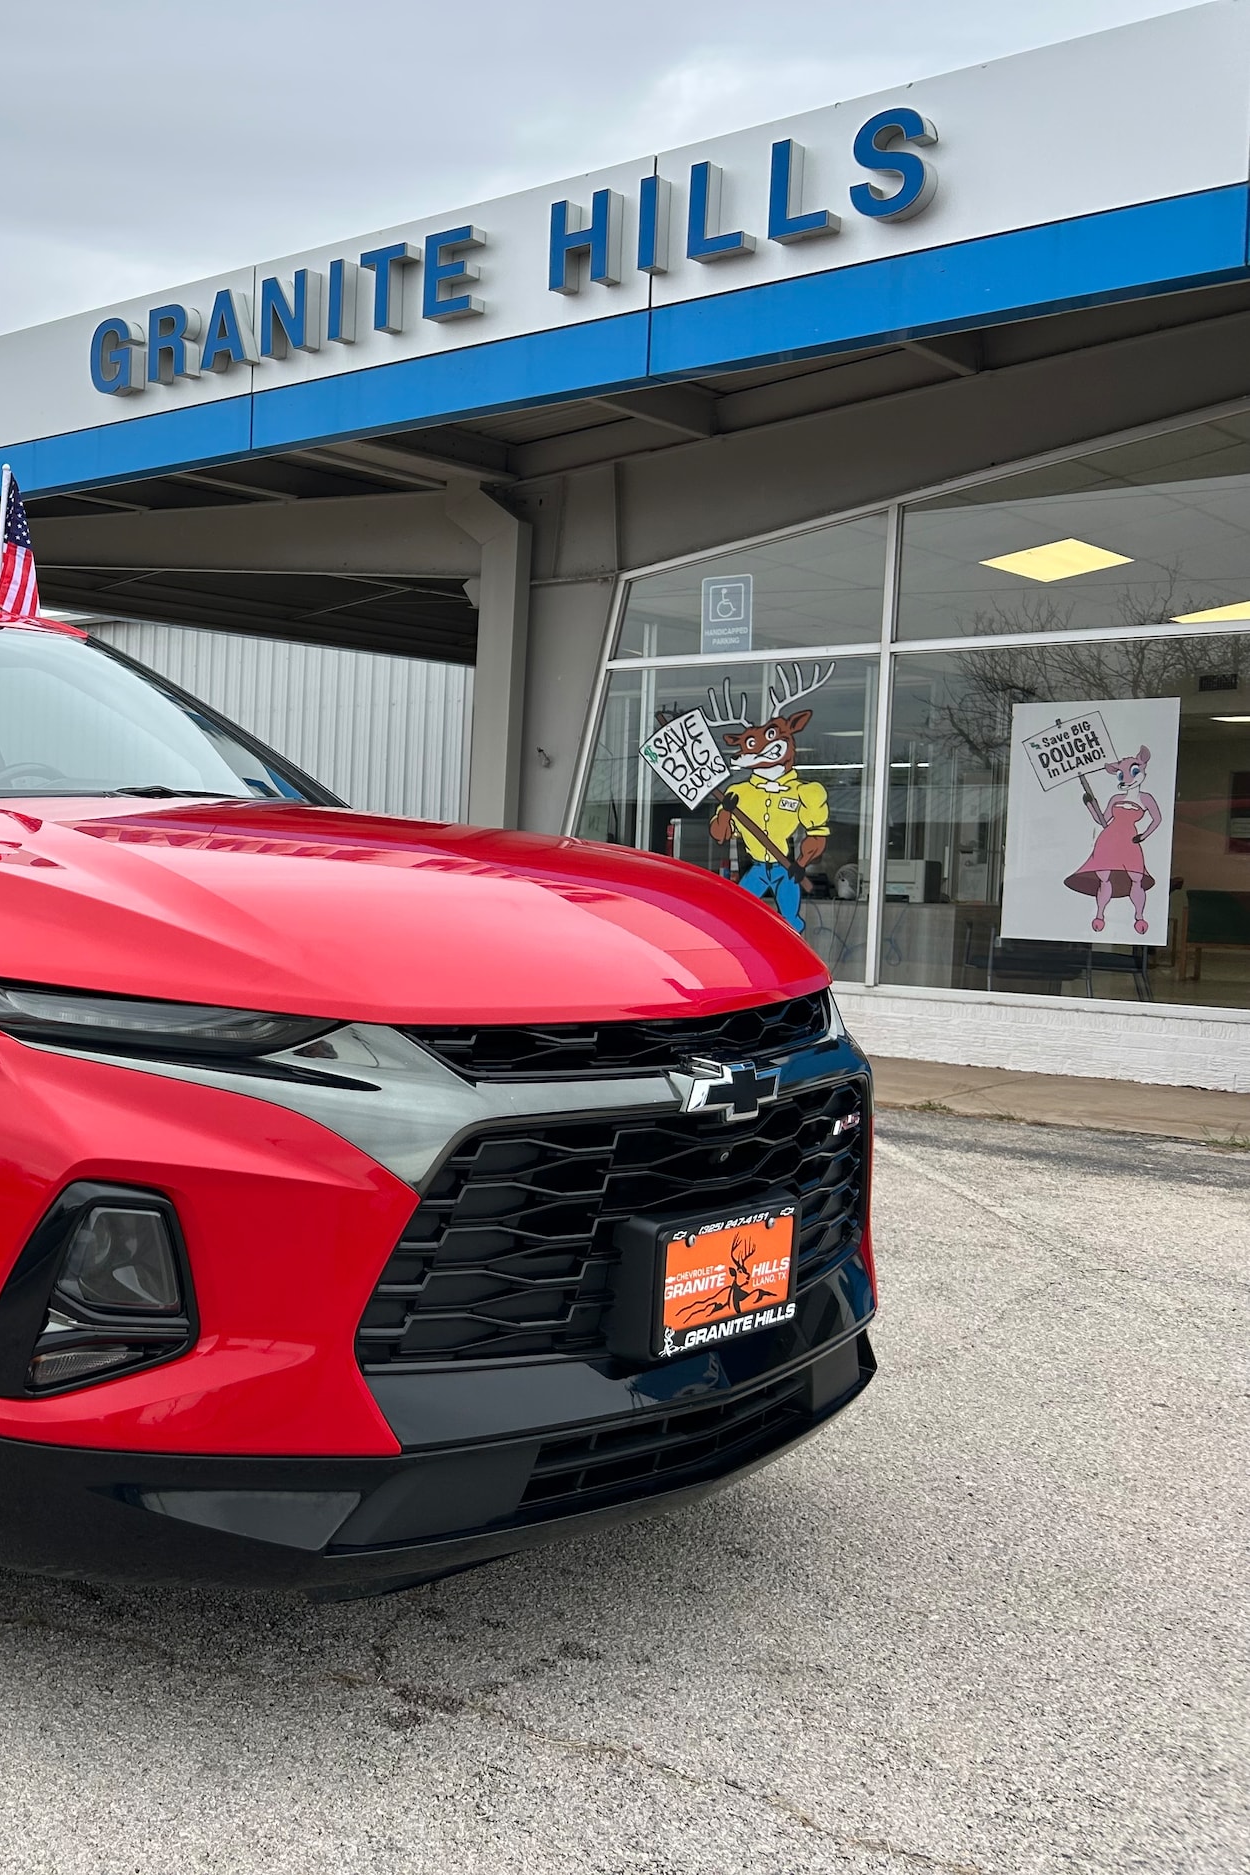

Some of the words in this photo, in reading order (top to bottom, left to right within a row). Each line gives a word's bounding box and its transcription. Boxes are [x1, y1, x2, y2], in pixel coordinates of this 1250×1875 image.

[90, 224, 486, 397] GRANITE
[548, 106, 939, 296] HILLS
[704, 626, 749, 636] HANDICAPPED
[712, 636, 740, 645] PARKING
[653, 714, 704, 758] SAVE
[1038, 731, 1101, 769] DOUGH
[1042, 731, 1070, 748] Save
[1070, 720, 1091, 736] BIG
[661, 739, 710, 782] BIG
[678, 755, 726, 801] BUCKS
[1047, 768, 1060, 779] in
[1060, 747, 1106, 773] LLANO!
[698, 1221, 724, 1235] (325)
[664, 1272, 727, 1300] GRANITE
[751, 1256, 790, 1278] HILLS
[676, 1265, 714, 1282] CHEVROLET
[752, 1275, 776, 1288] LLANO,
[777, 1271, 787, 1281] TX
[684, 1314, 754, 1348] GRANITE
[754, 1302, 796, 1328] HILLS
